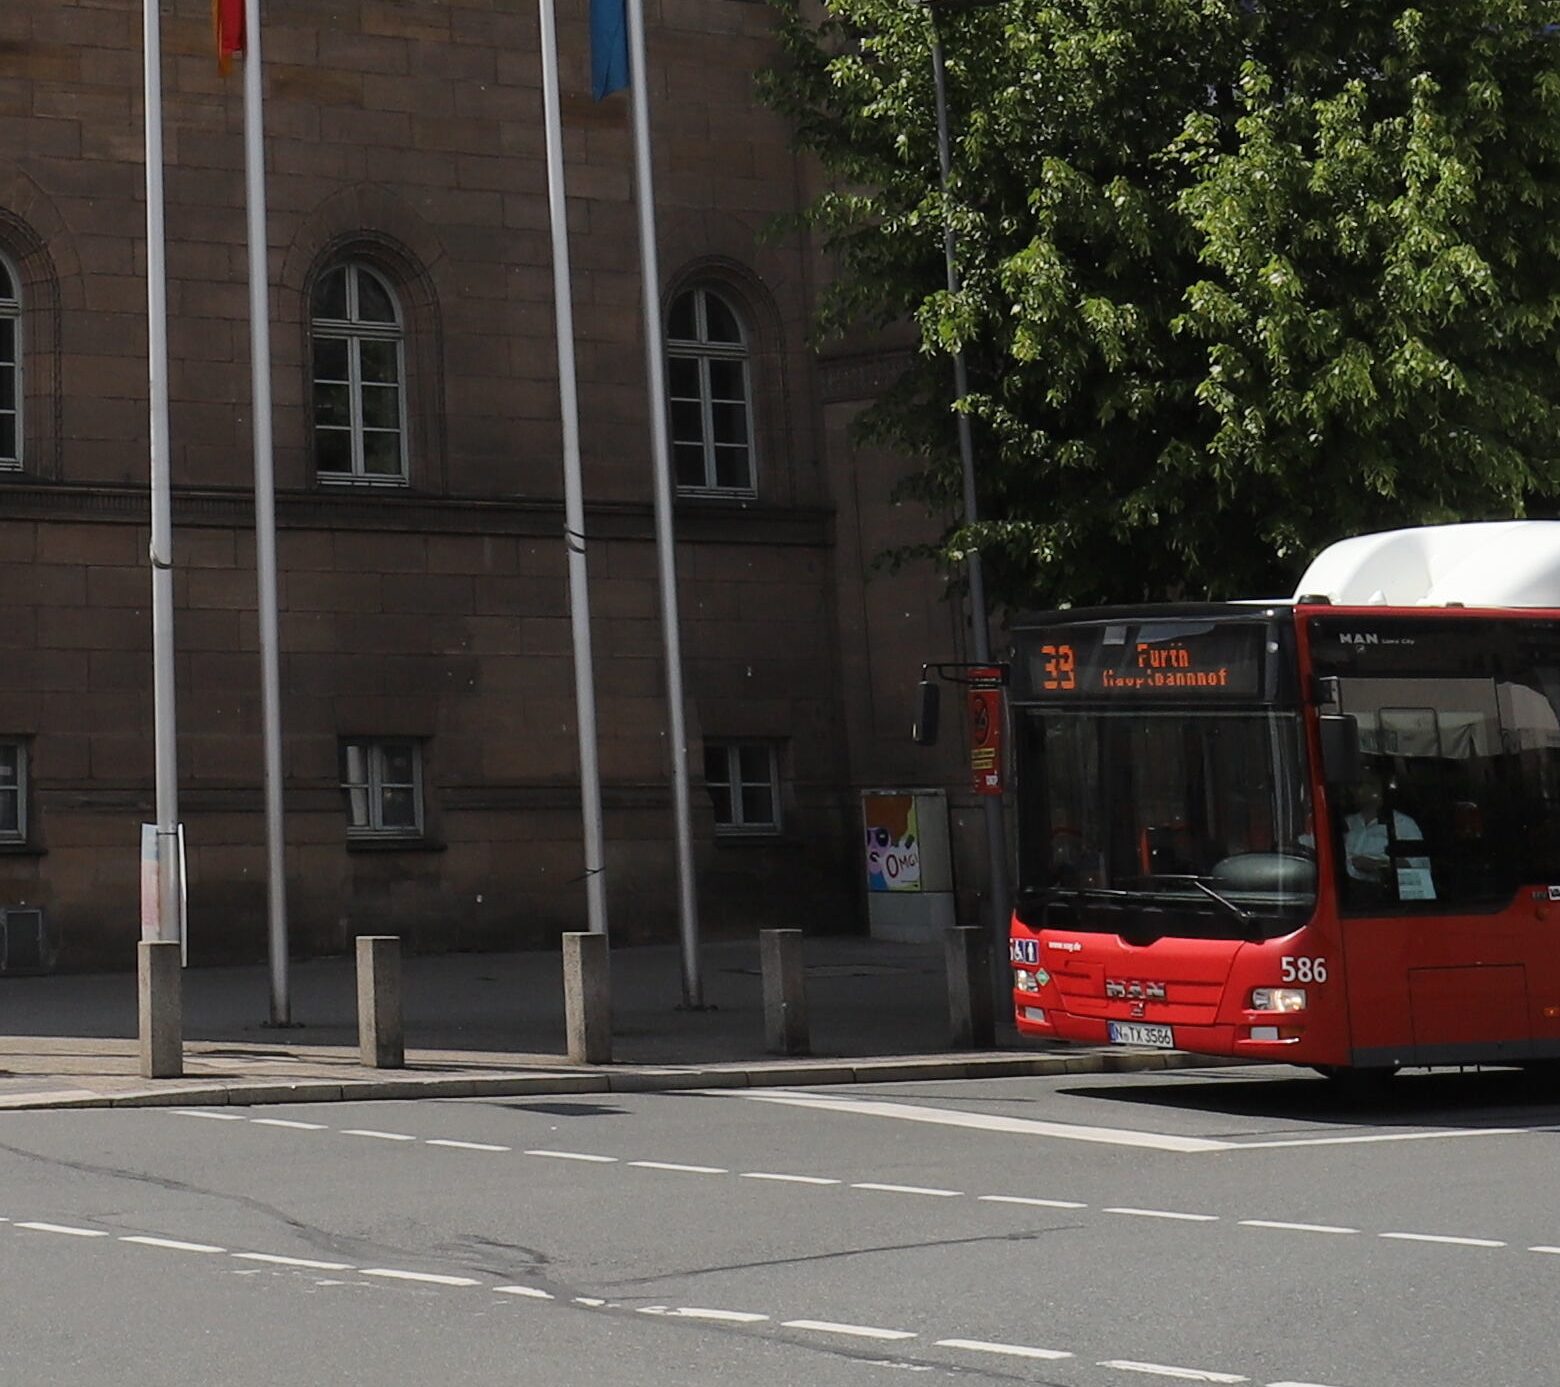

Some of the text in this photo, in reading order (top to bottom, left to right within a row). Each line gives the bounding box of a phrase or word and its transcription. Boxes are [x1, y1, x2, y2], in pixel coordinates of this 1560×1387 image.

[1339, 633, 1379, 645] MAN
[1280, 956, 1328, 984] 586
[1105, 978, 1166, 1000] MAN
[1128, 1026, 1144, 1042] TX
[1144, 1027, 1171, 1045] 3586
